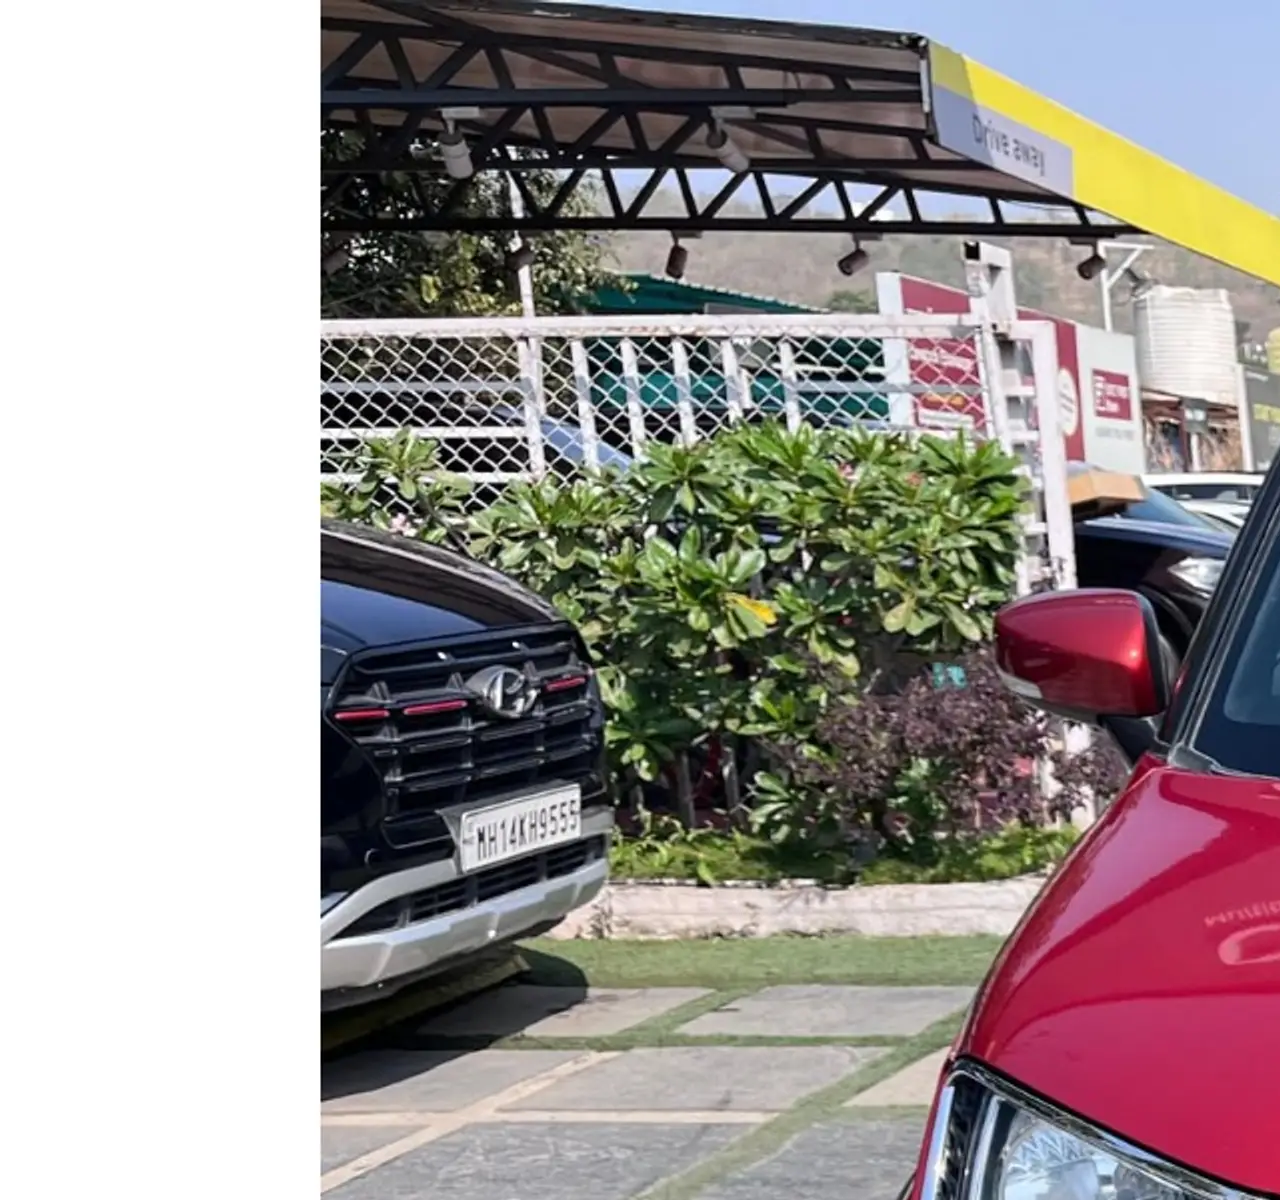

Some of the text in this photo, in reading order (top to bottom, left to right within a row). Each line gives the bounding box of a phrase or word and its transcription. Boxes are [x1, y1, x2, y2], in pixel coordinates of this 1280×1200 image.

[972, 112, 1045, 177] Drive away
[476, 798, 578, 861] MH14KH9555
